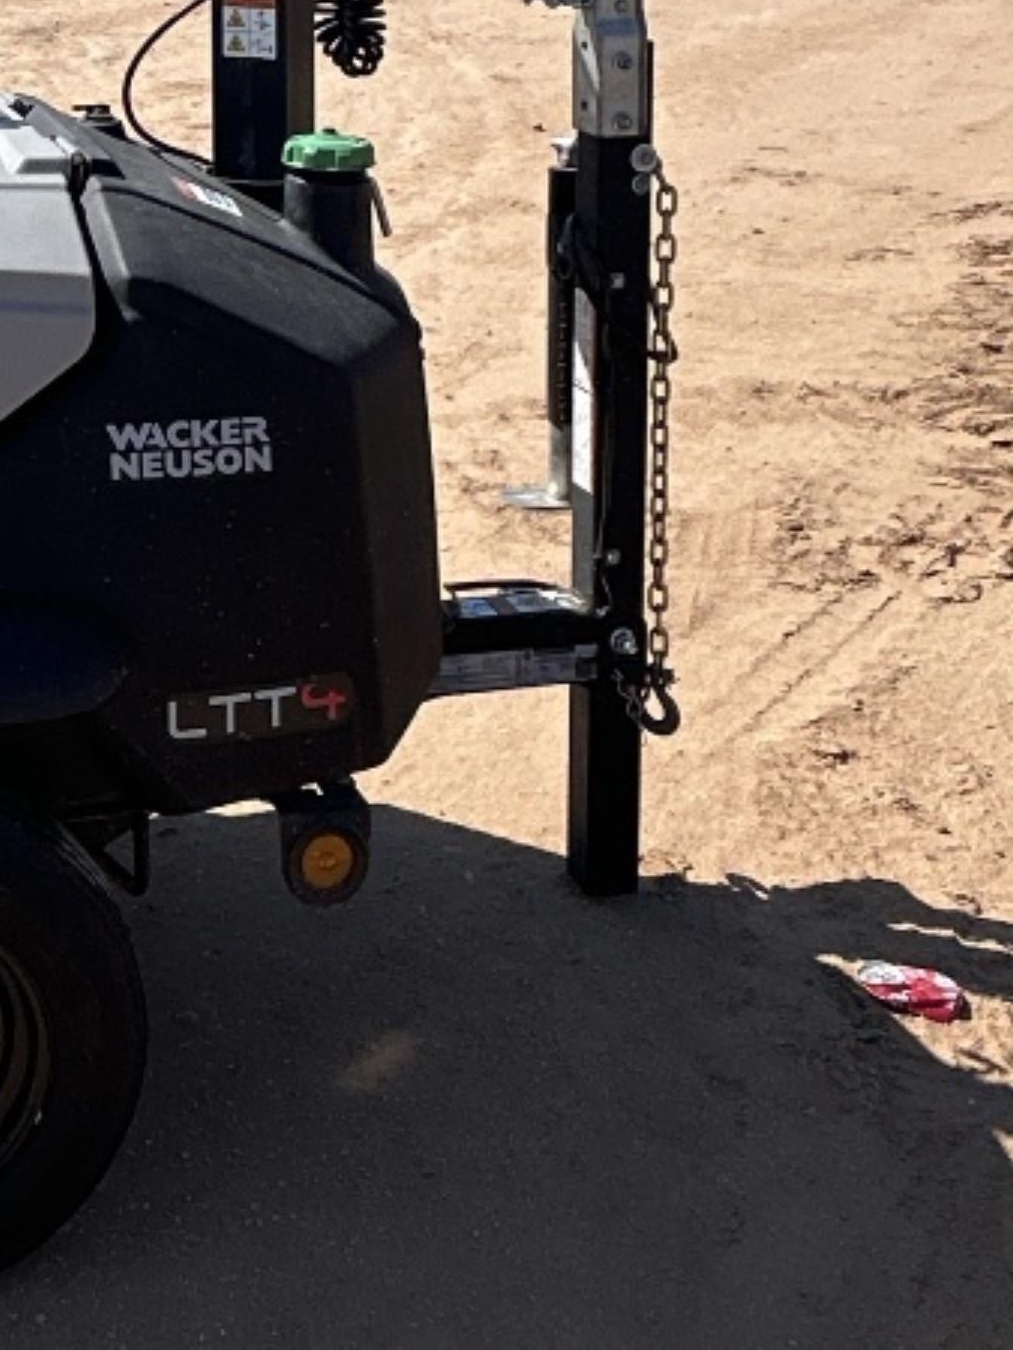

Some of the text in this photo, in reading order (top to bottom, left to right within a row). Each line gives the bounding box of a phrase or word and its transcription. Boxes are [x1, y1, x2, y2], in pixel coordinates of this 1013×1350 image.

[106, 416, 270, 450] WACKER
[109, 445, 273, 481] NEUSON
[168, 683, 346, 739] LTT4
